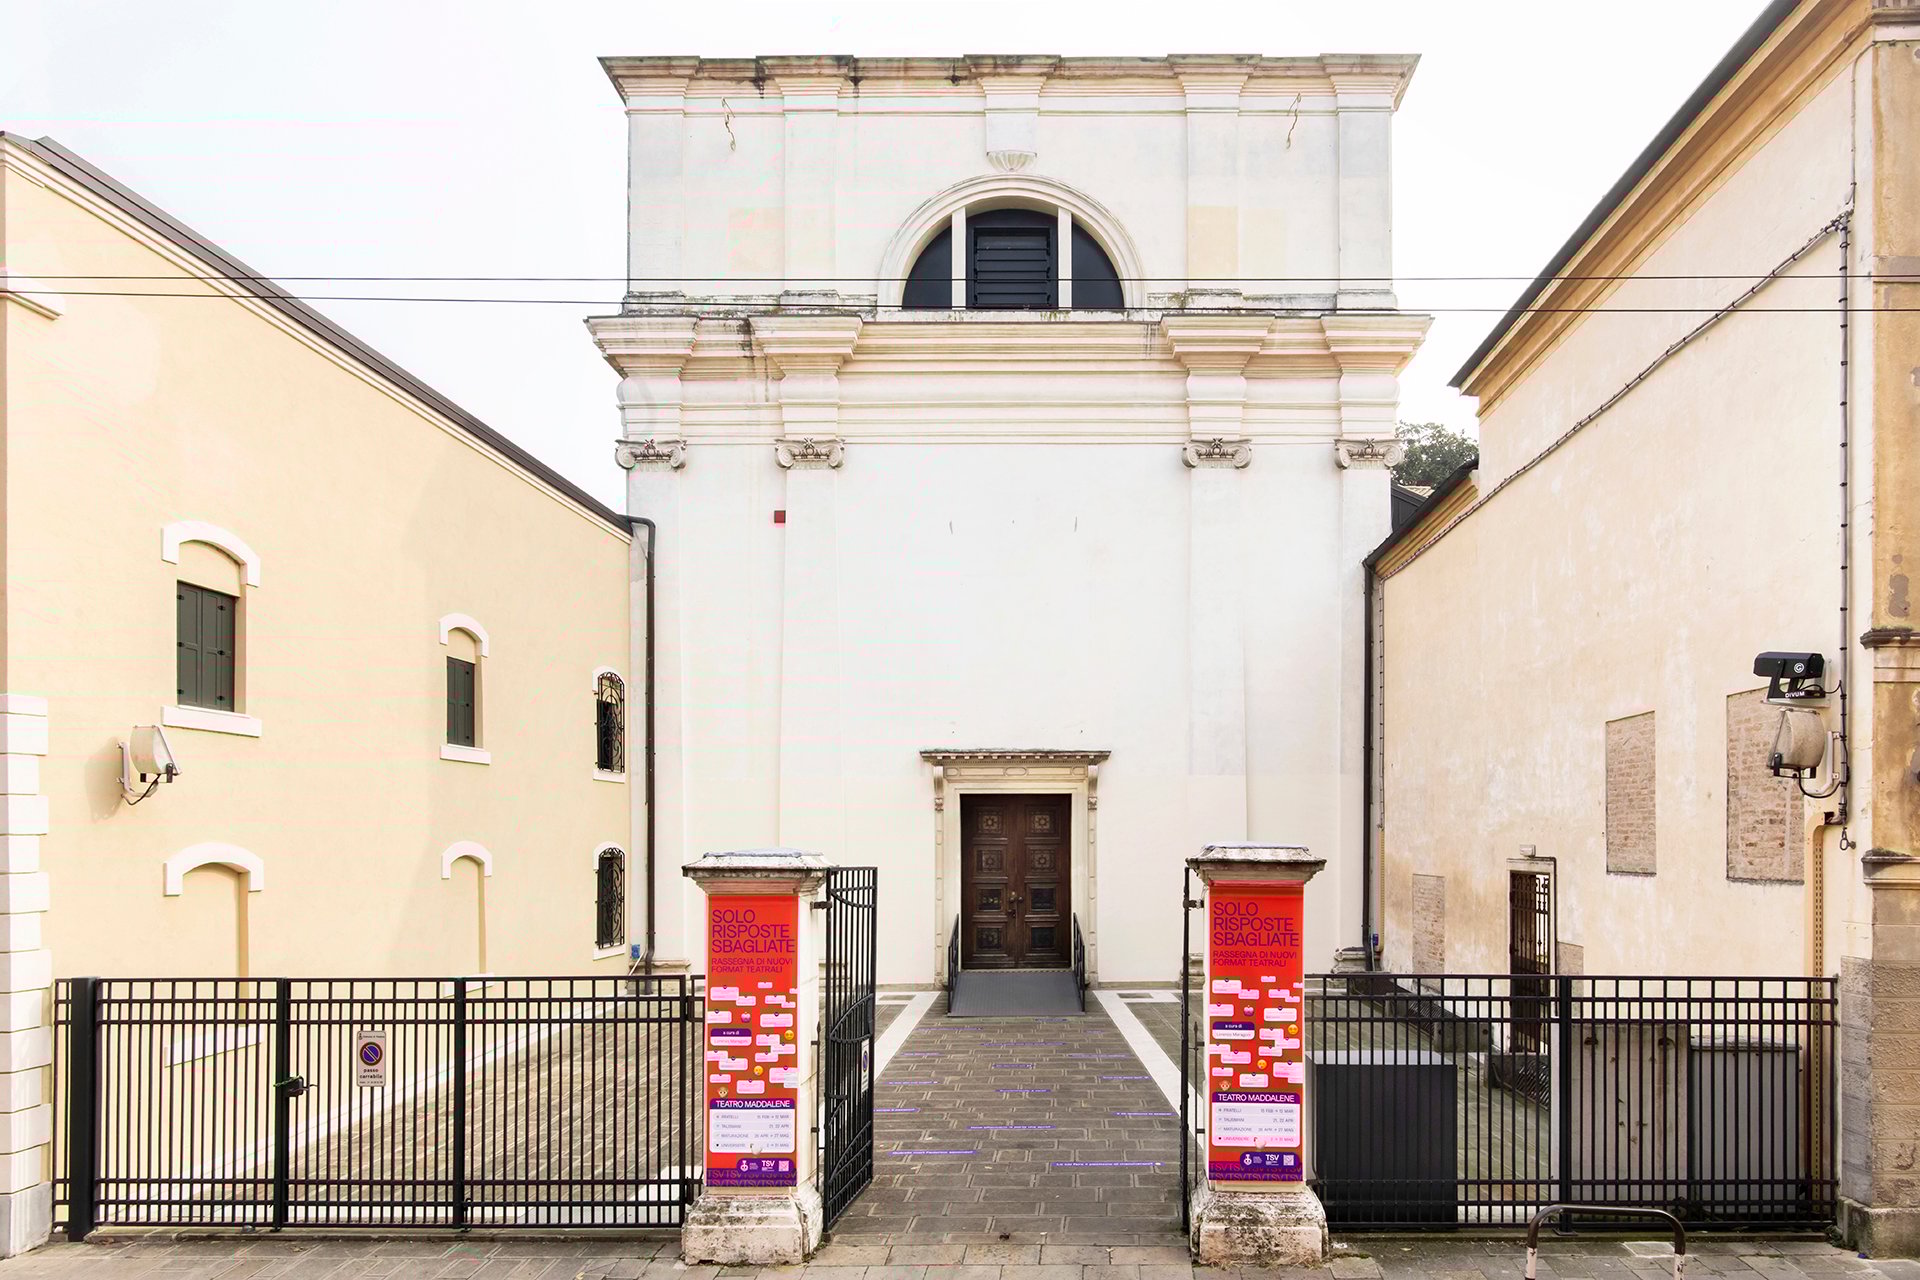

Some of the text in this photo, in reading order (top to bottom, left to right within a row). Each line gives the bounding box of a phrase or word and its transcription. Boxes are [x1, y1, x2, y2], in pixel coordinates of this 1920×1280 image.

[1214, 902, 1258, 916] SOLO
[712, 910, 755, 923] SOLO
[712, 924, 790, 938] RISPOSTE
[1214, 917, 1293, 931] RISPOSTE
[1214, 932, 1299, 946] SBAGLIATE
[712, 940, 795, 953] SBAGLIATE
